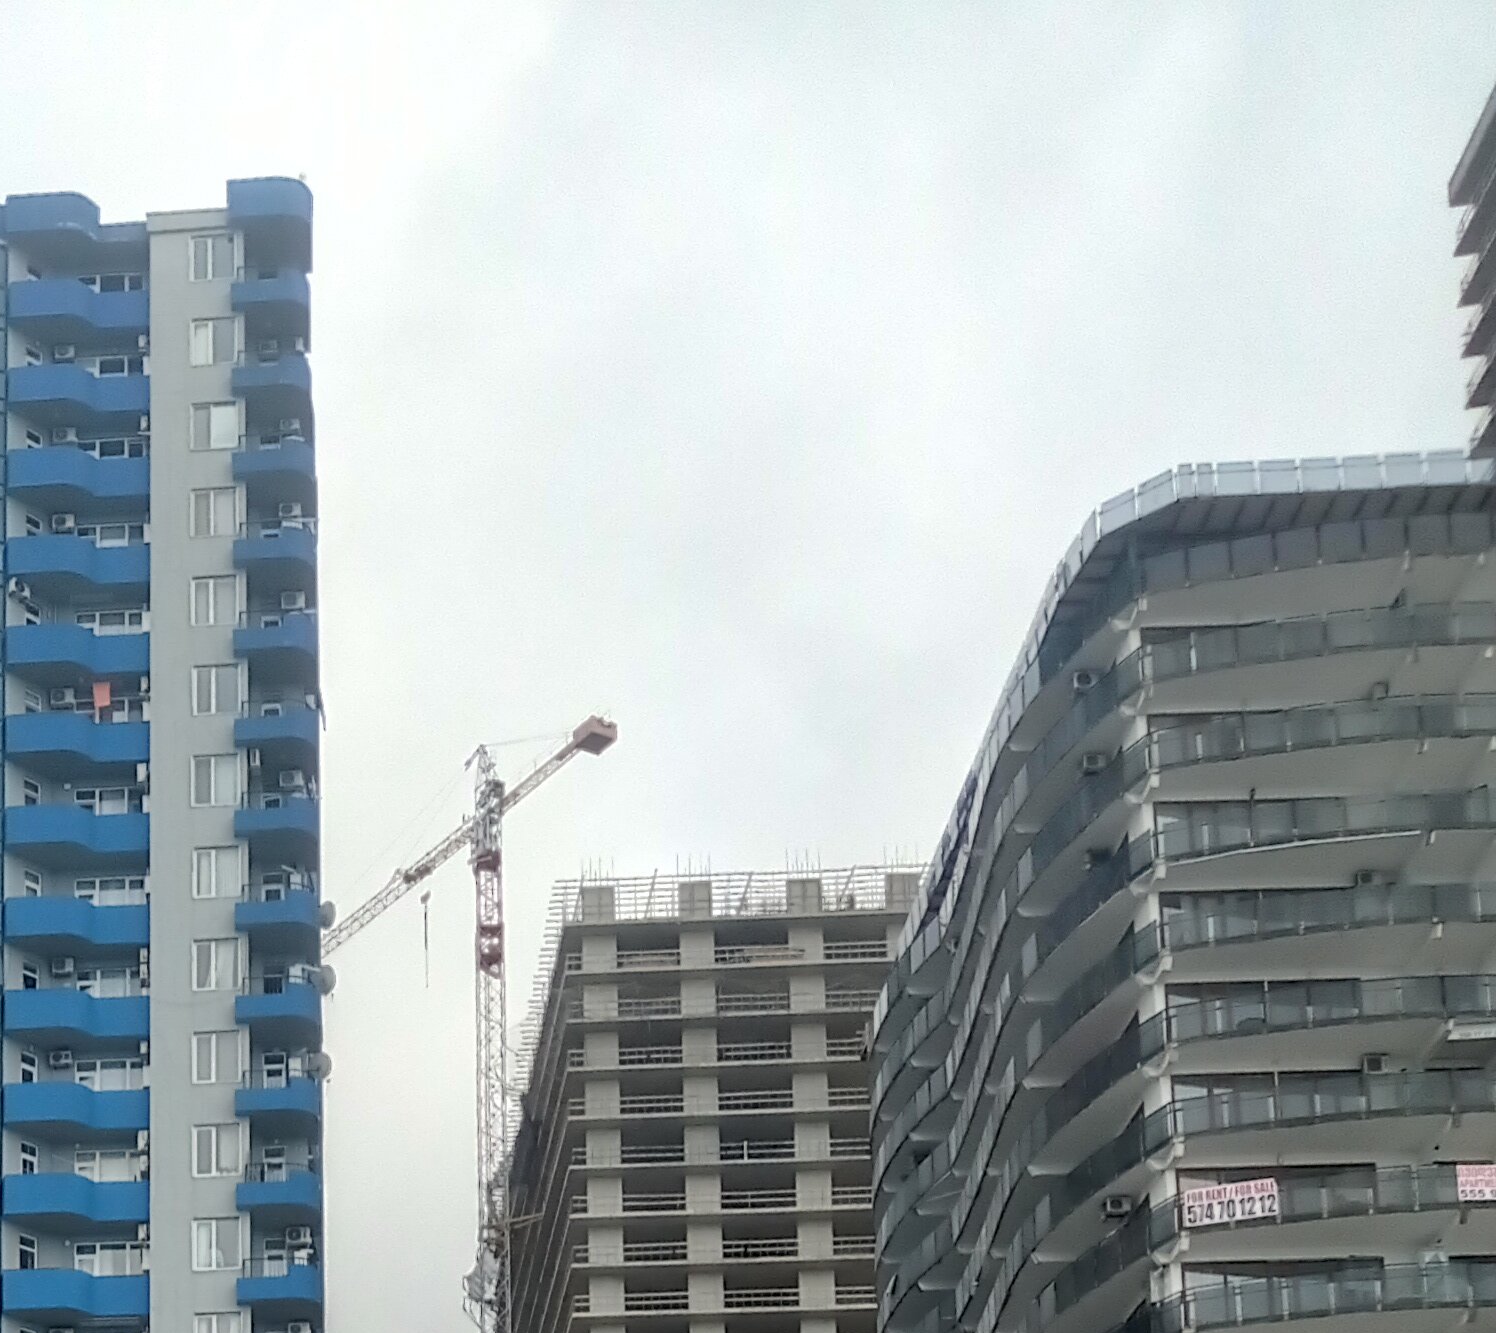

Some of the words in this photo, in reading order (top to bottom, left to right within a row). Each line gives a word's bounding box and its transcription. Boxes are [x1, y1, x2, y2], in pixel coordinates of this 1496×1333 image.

[1186, 1190, 1204, 1204] FOR
[1205, 1187, 1227, 1201] RENT
[1234, 1184, 1252, 1197] FOR
[1253, 1181, 1275, 1194] SALE
[1187, 1202, 1216, 1224] 574
[1217, 1199, 1237, 1219] 70
[1239, 1196, 1256, 1216] 12
[1259, 1194, 1277, 1213] 12
